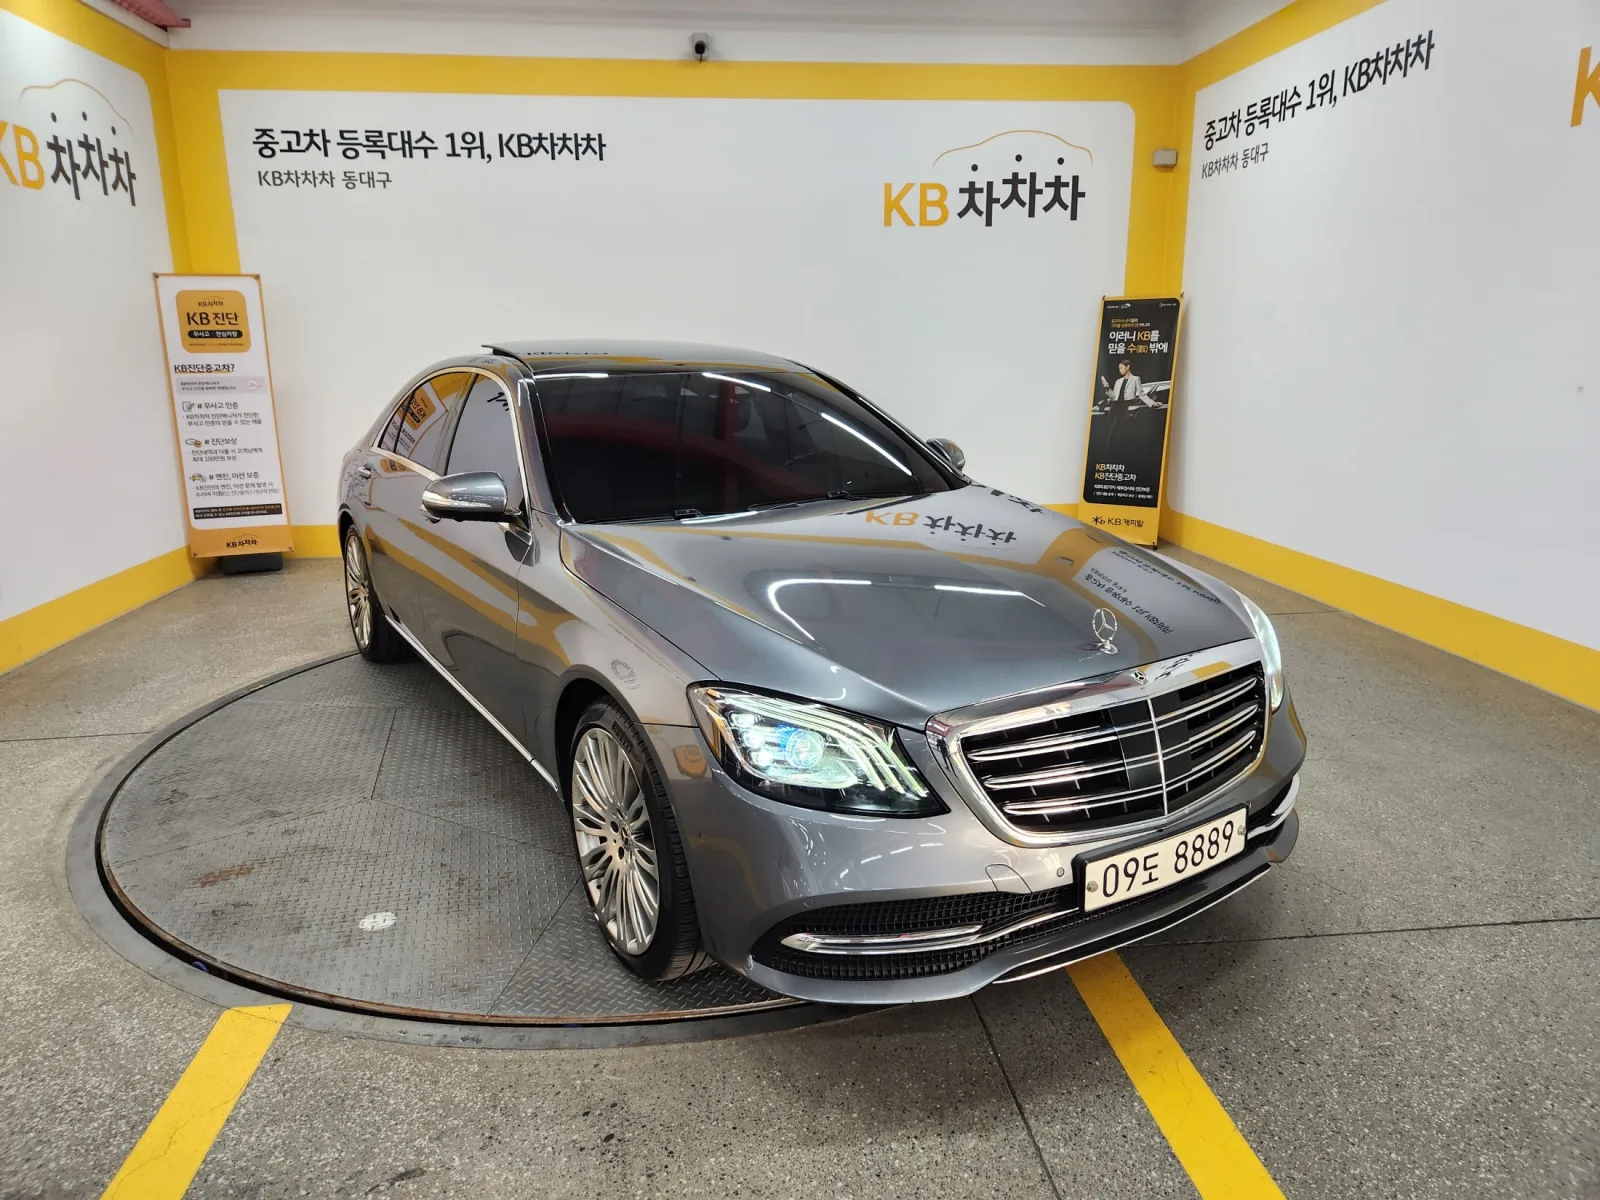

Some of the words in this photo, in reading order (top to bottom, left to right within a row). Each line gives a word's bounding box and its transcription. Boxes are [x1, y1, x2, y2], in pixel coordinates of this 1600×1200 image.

[1204, 108, 1242, 150] 중고차
[1244, 86, 1302, 136] 등록대수
[1306, 70, 1338, 110] 1위,
[1342, 30, 1435, 97] KB차차차
[252, 128, 331, 158] 중고차
[336, 128, 438, 160] 등록대수
[445, 130, 492, 163] 1위,
[498, 132, 606, 160] KB차차차
[46, 112, 136, 207] 차차차
[1202, 152, 1238, 180] KB차차차
[1241, 142, 1268, 169] 동대구
[258, 170, 336, 188] KB차차차
[342, 170, 392, 190] 동대구
[884, 182, 950, 227] KB
[956, 154, 1086, 227] 차차차
[186, 312, 210, 325] KB
[212, 312, 239, 326] 진단
[1109, 330, 1136, 342] 이러니
[1137, 330, 1160, 341] KB를
[1108, 342, 1126, 354] 믿을
[1150, 342, 1168, 353] 밖에
[174, 364, 235, 373] KB진단중고차?
[1095, 472, 1136, 482] KB진단중고차
[1096, 464, 1125, 472] KB차차차
[1102, 852, 1159, 898] 09도
[1174, 820, 1234, 874] 8889
